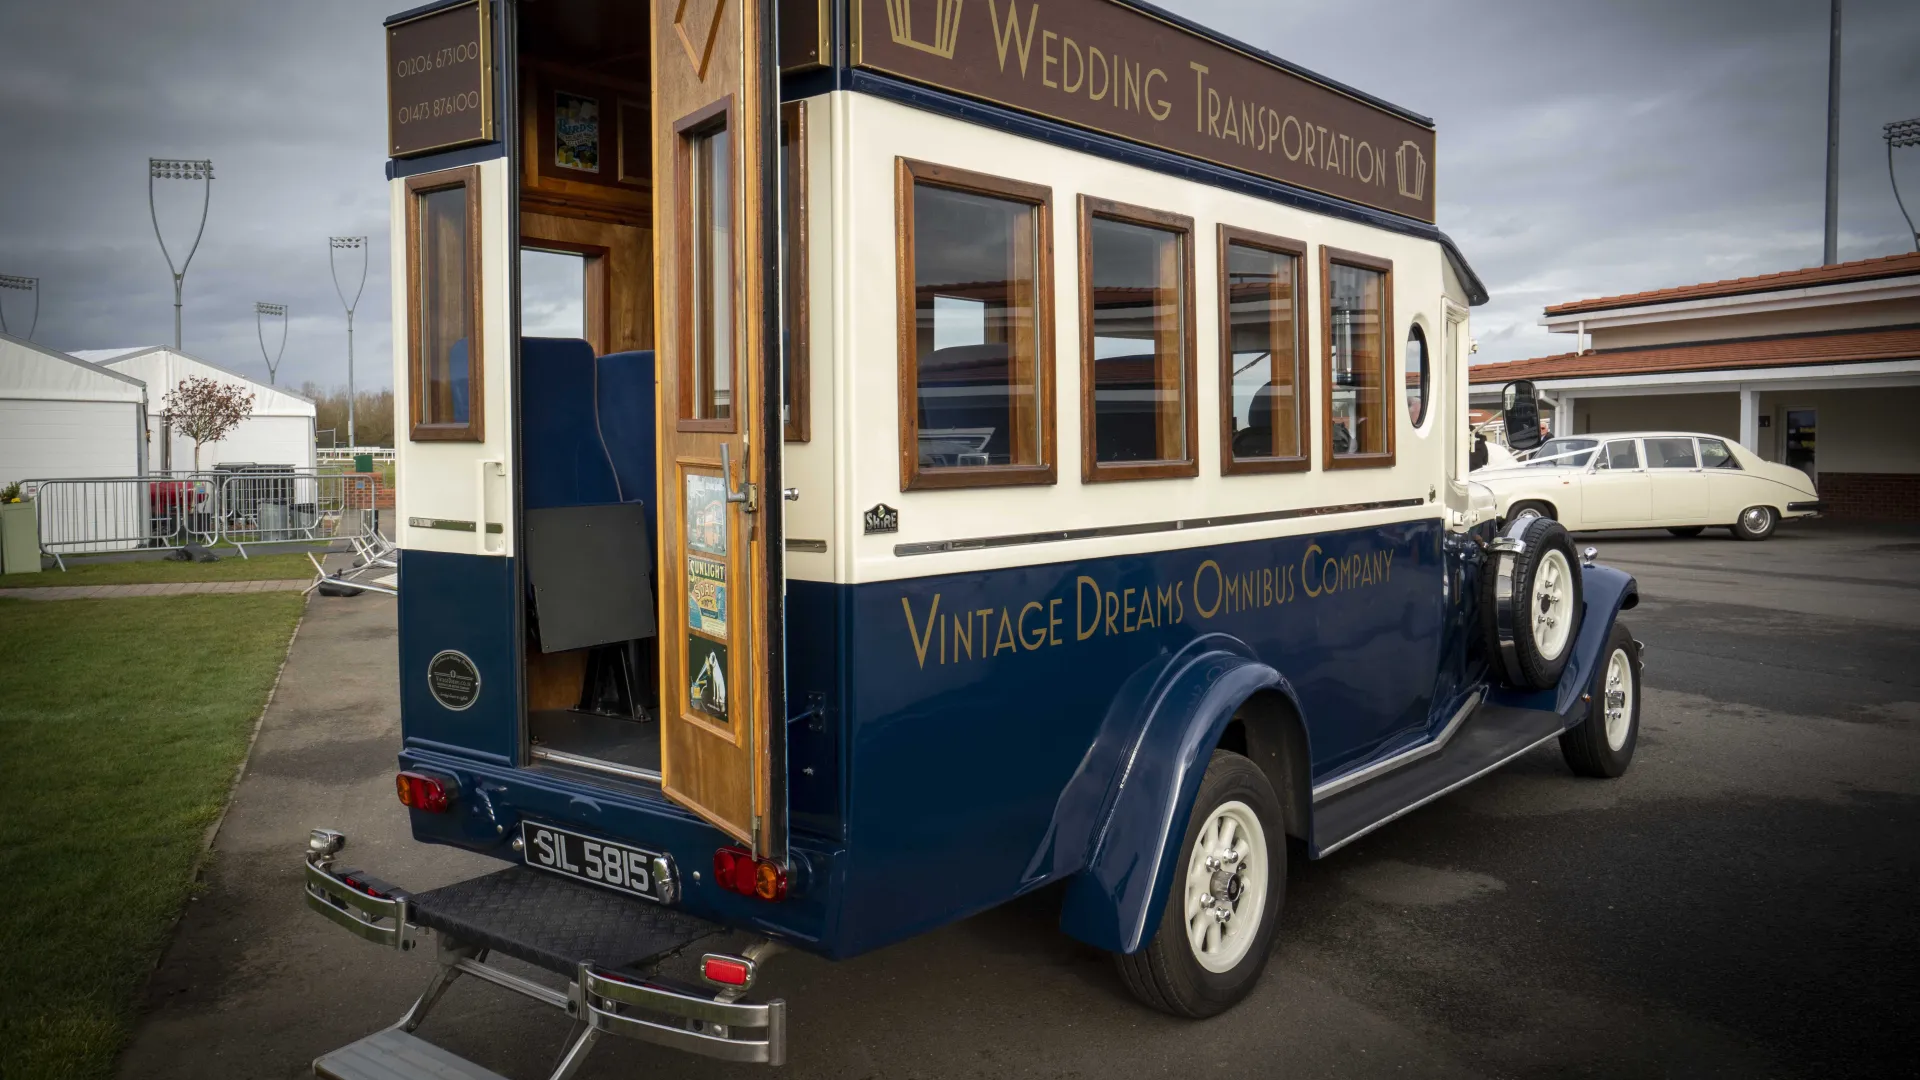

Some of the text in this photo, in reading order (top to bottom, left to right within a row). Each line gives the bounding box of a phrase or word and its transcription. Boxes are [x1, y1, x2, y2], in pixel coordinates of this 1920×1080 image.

[397, 41, 479, 78] 01206 673100
[398, 90, 479, 124] 01473 876100
[988, 0, 1386, 188] WEDDING TRANSPORTATION
[690, 560, 725, 583] SUNLIGHT
[694, 584, 715, 600] SOAP
[901, 544, 1395, 671] VINTAGE DREAMS OMNIBUS COMPANY
[536, 829, 649, 892] SIL 5815
